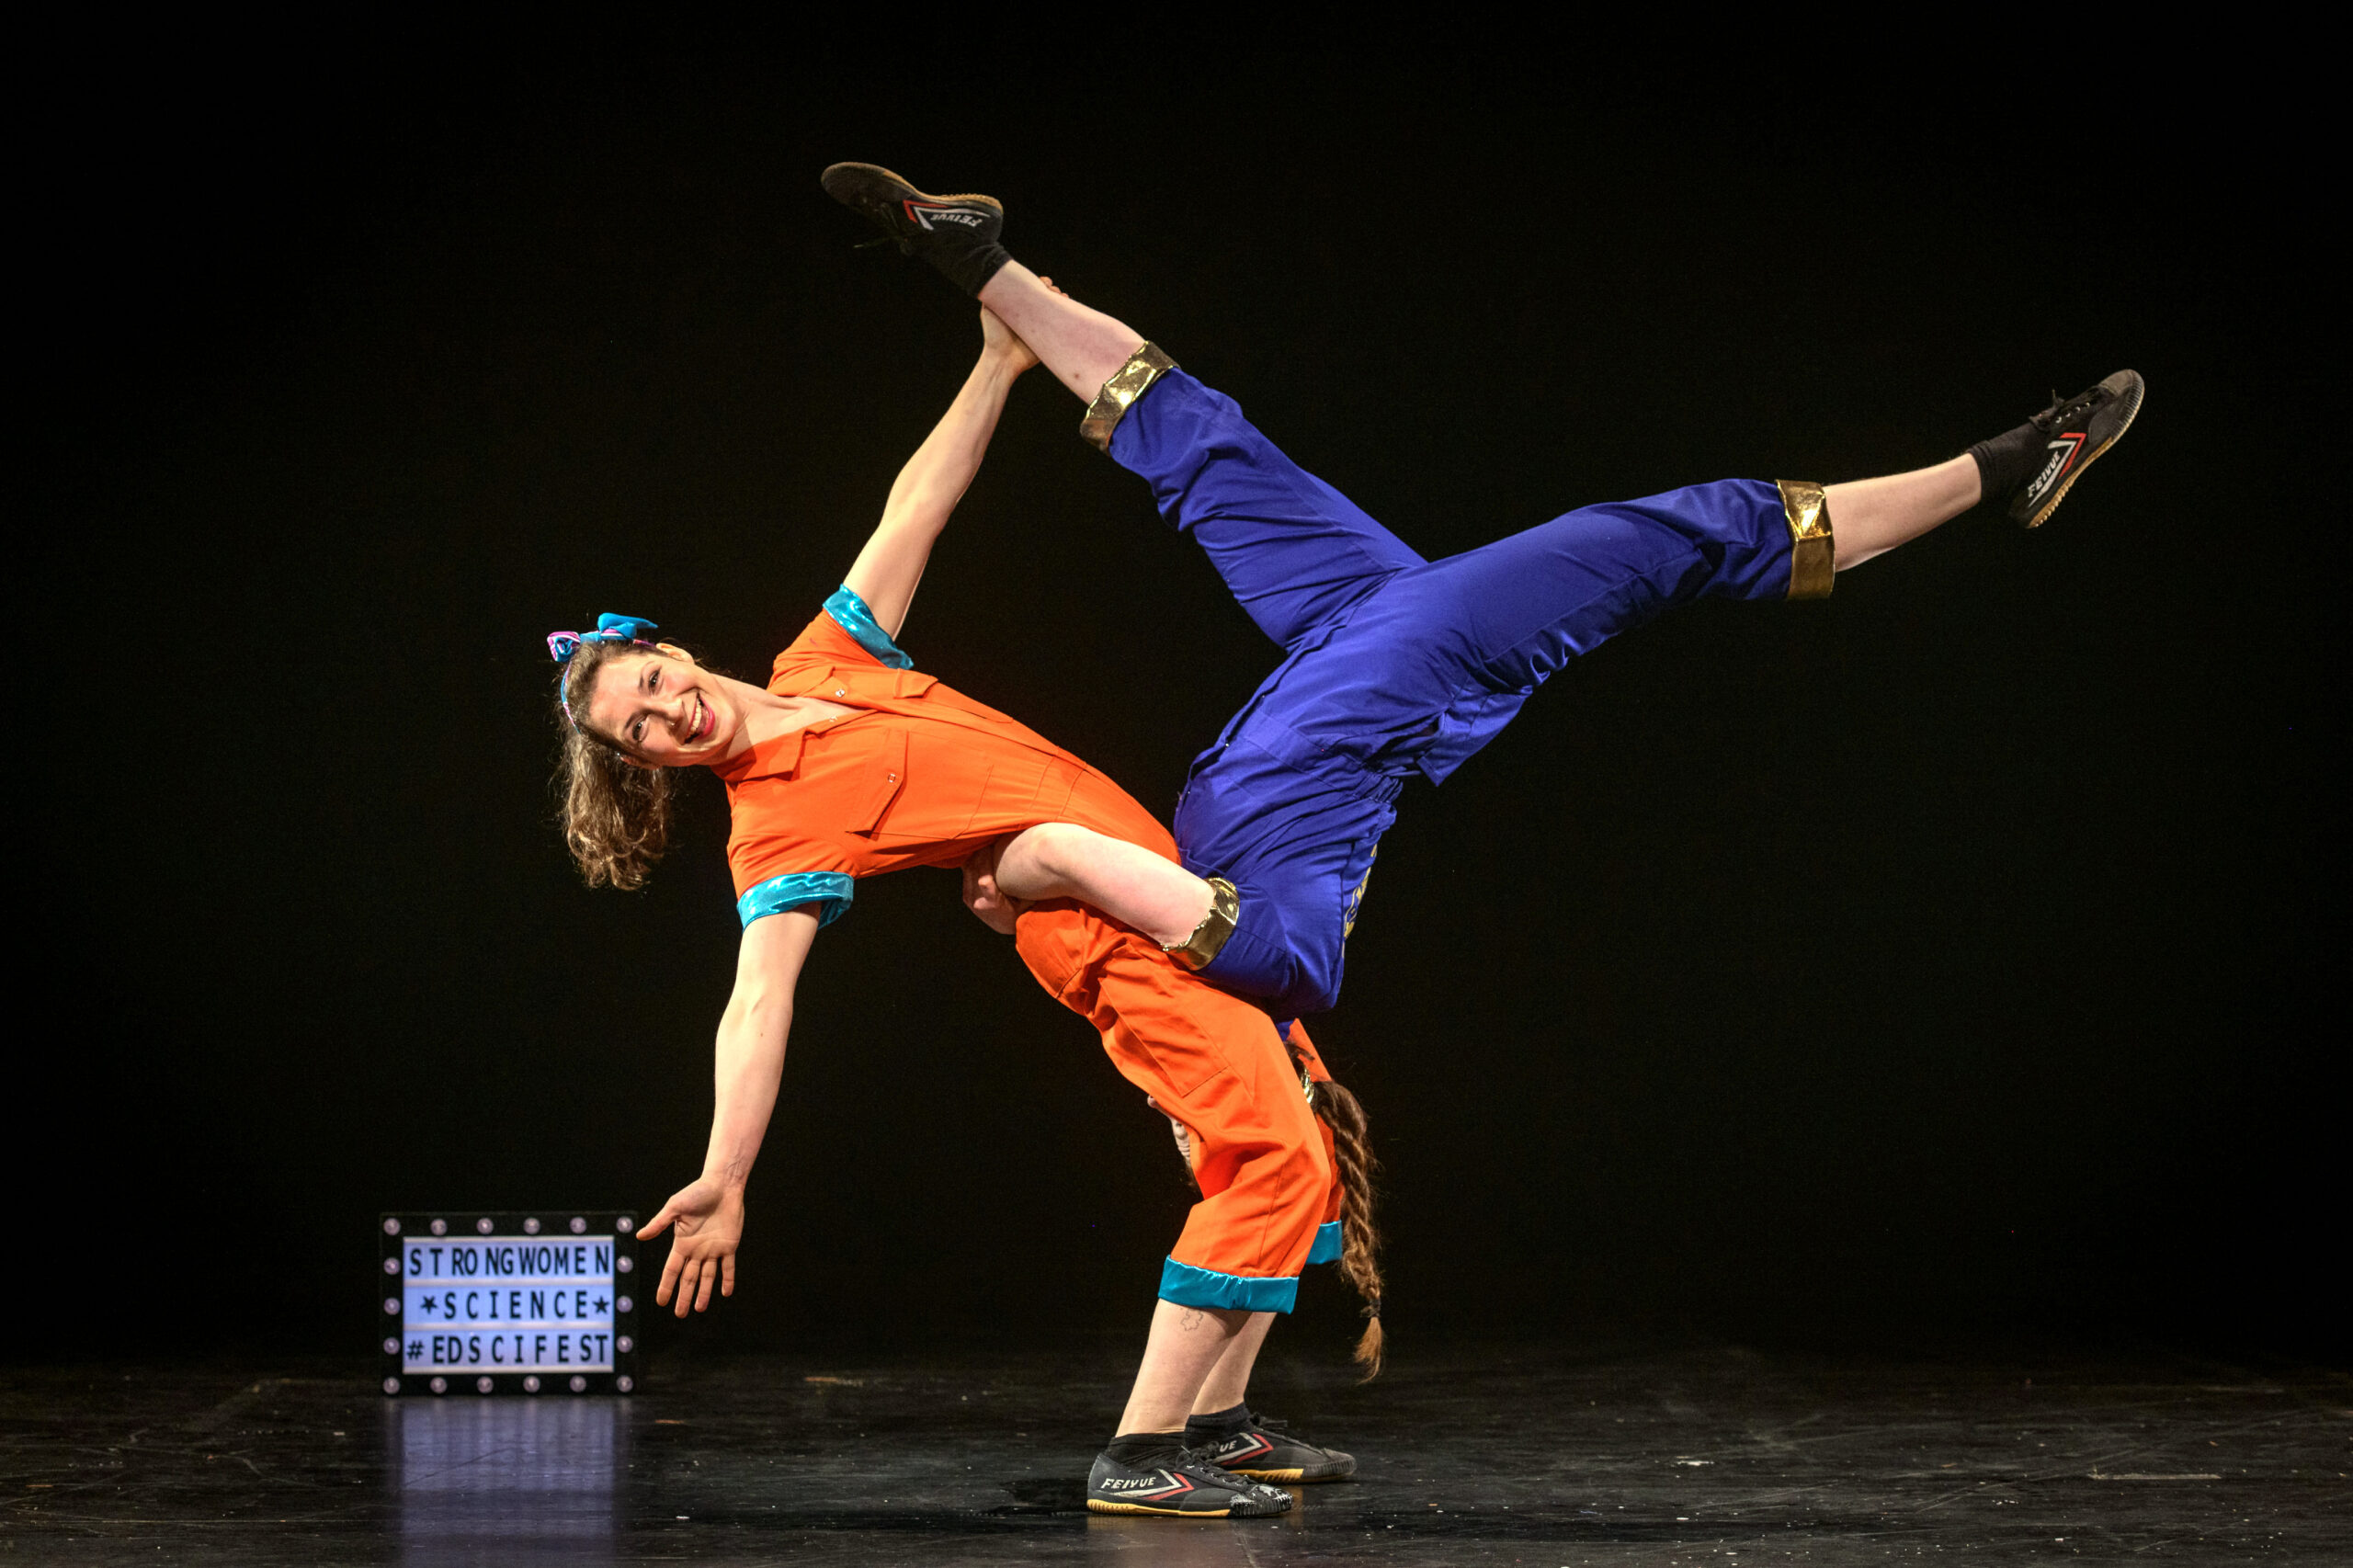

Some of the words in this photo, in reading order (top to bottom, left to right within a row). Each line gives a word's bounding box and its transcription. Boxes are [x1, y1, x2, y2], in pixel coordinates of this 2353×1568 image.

[410, 1245, 609, 1276] STRONGWOMEN
[444, 1290, 587, 1319] SCIENCE
[406, 1335, 608, 1363] #EDSCIFEST
[1100, 1476, 1156, 1489] FEIYUE
